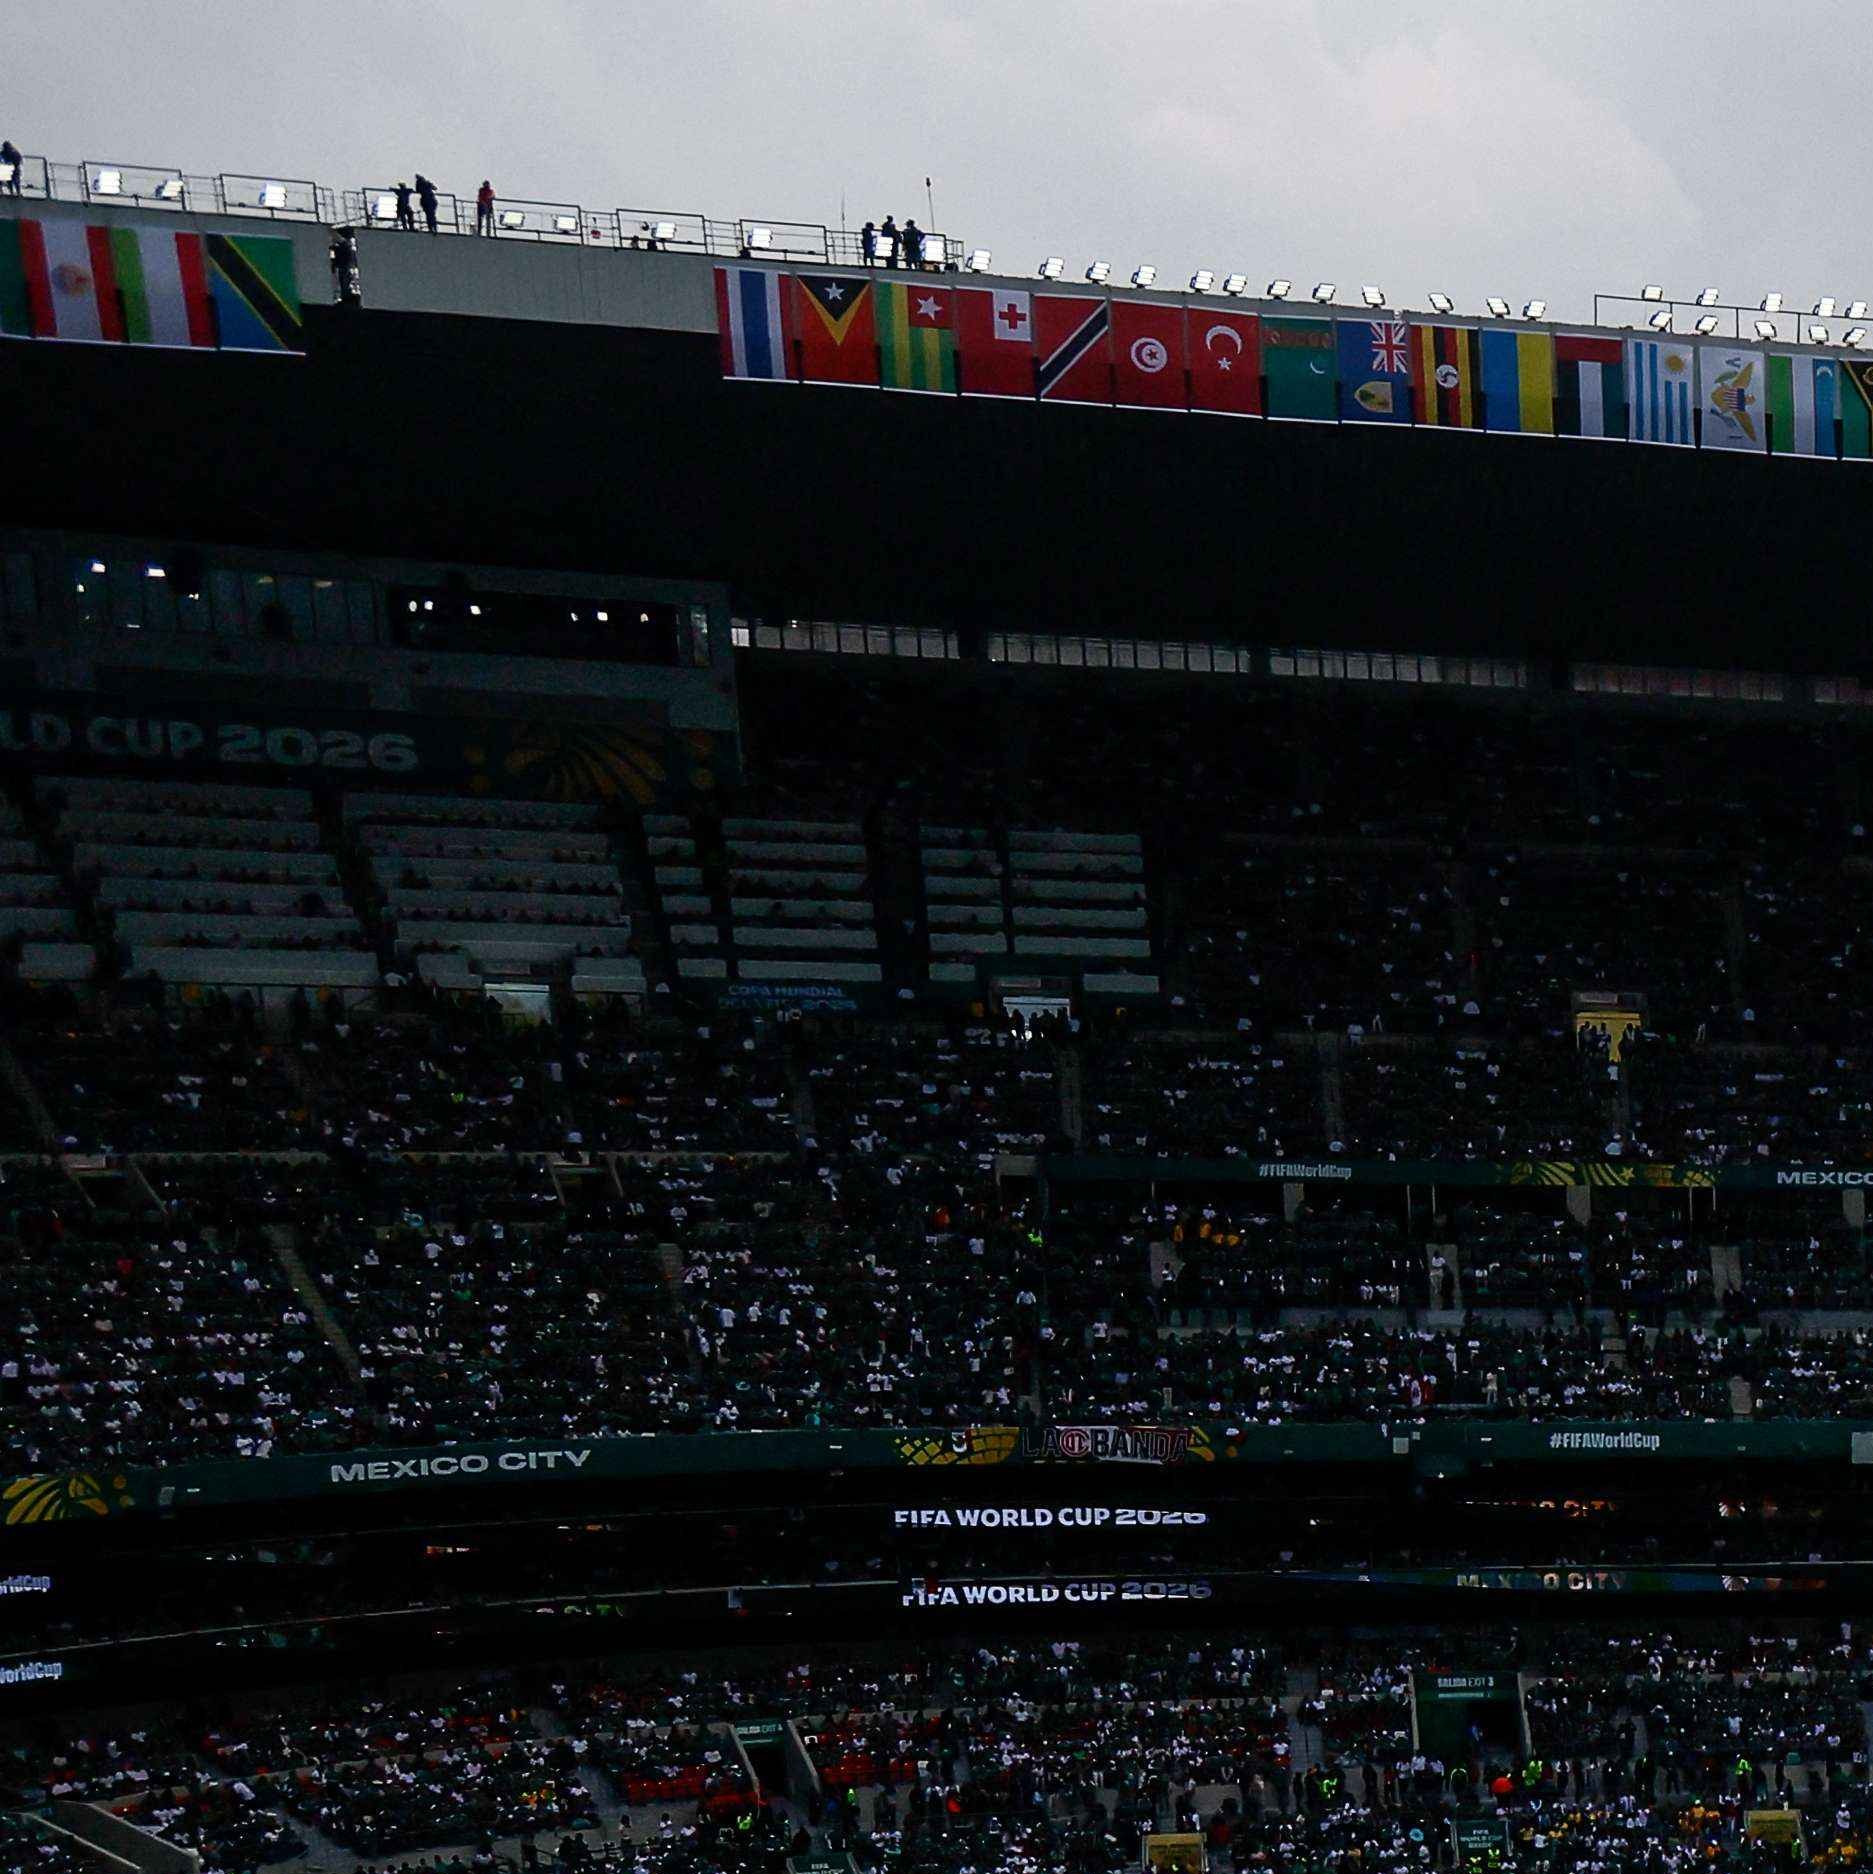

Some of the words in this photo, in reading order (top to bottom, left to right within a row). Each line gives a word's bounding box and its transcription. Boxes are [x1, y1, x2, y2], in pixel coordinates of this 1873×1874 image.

[86, 716, 204, 759] CUP
[218, 722, 420, 773] 2026
[1091, 1428, 1188, 1460] BANDA
[1550, 1432, 1660, 1451] #FIFAWorldCup
[331, 1454, 489, 1483] MEXICO
[499, 1450, 592, 1470] CITY
[895, 1508, 951, 1528] FIFA
[956, 1508, 1054, 1527] WORLD
[1058, 1507, 1110, 1526] CUP
[1115, 1508, 1208, 1526] 2026
[963, 1585, 1060, 1605] WORLD
[1064, 1582, 1116, 1602] CUP
[1121, 1581, 1214, 1600] 2026
